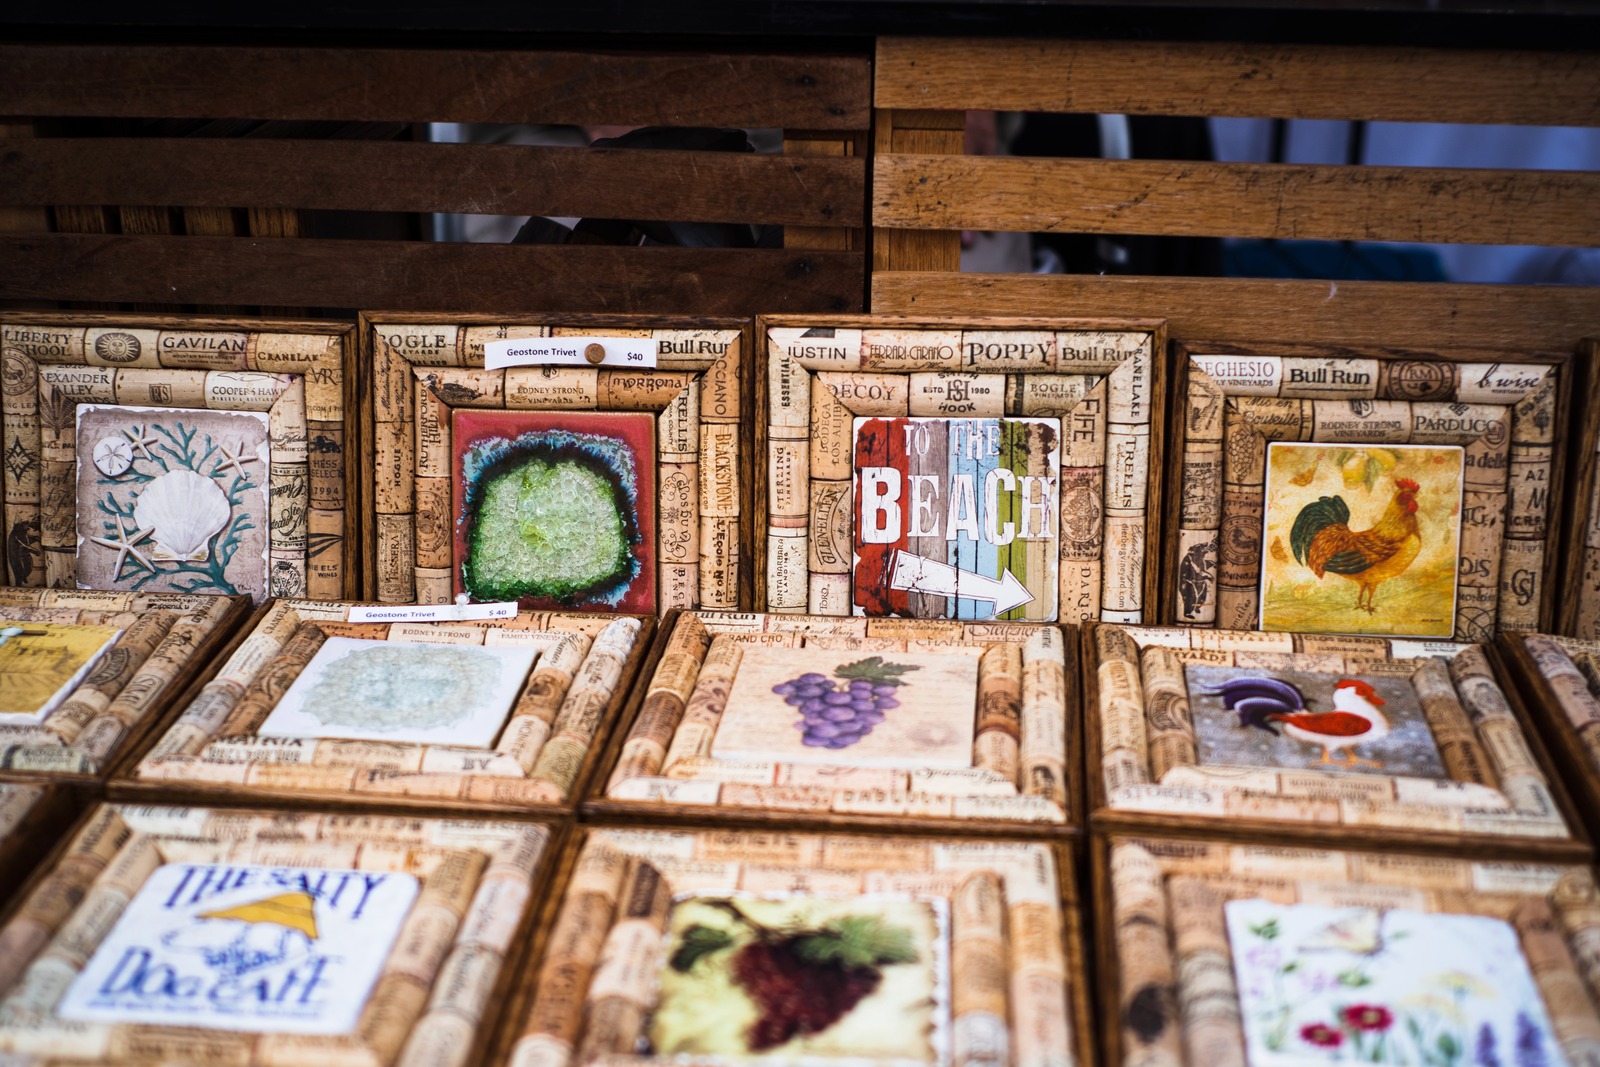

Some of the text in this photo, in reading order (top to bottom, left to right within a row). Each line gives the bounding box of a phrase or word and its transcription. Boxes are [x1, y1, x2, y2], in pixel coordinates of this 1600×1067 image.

[4, 329, 72, 344] LIBERTY
[163, 337, 245, 352] GAVILAN
[17, 344, 71, 357] HOOL
[506, 348, 644, 362] Geostone Trivet $40
[658, 340, 694, 354] Bull
[968, 342, 1052, 368] POPPY
[1062, 346, 1098, 361] Bull
[781, 358, 790, 408] ESSENTIAL
[1290, 368, 1370, 385] Bull Run
[1496, 372, 1540, 388] wise
[518, 386, 550, 394] RODNEY
[1030, 384, 1078, 393] BOGLE
[678, 384, 690, 452] TRELLIS
[1073, 398, 1100, 442] FIFE
[1320, 421, 1402, 430] RODNEY STRONG
[420, 390, 428, 469] RUTHERFORD
[428, 416, 440, 444] HILL
[1334, 430, 1386, 438] VINEYARDS
[903, 420, 1000, 460] TO THE
[313, 460, 337, 469] HESS
[716, 433, 732, 511] BLACKSTONE
[1124, 436, 1137, 508] TRELLIS
[776, 446, 784, 510] STERLING
[314, 487, 339, 495] 1994
[861, 467, 1056, 546] BEACH
[390, 535, 400, 582] TESSERA
[402, 628, 471, 638] RODNEY STRONG
[163, 866, 389, 920] THE SALTY
